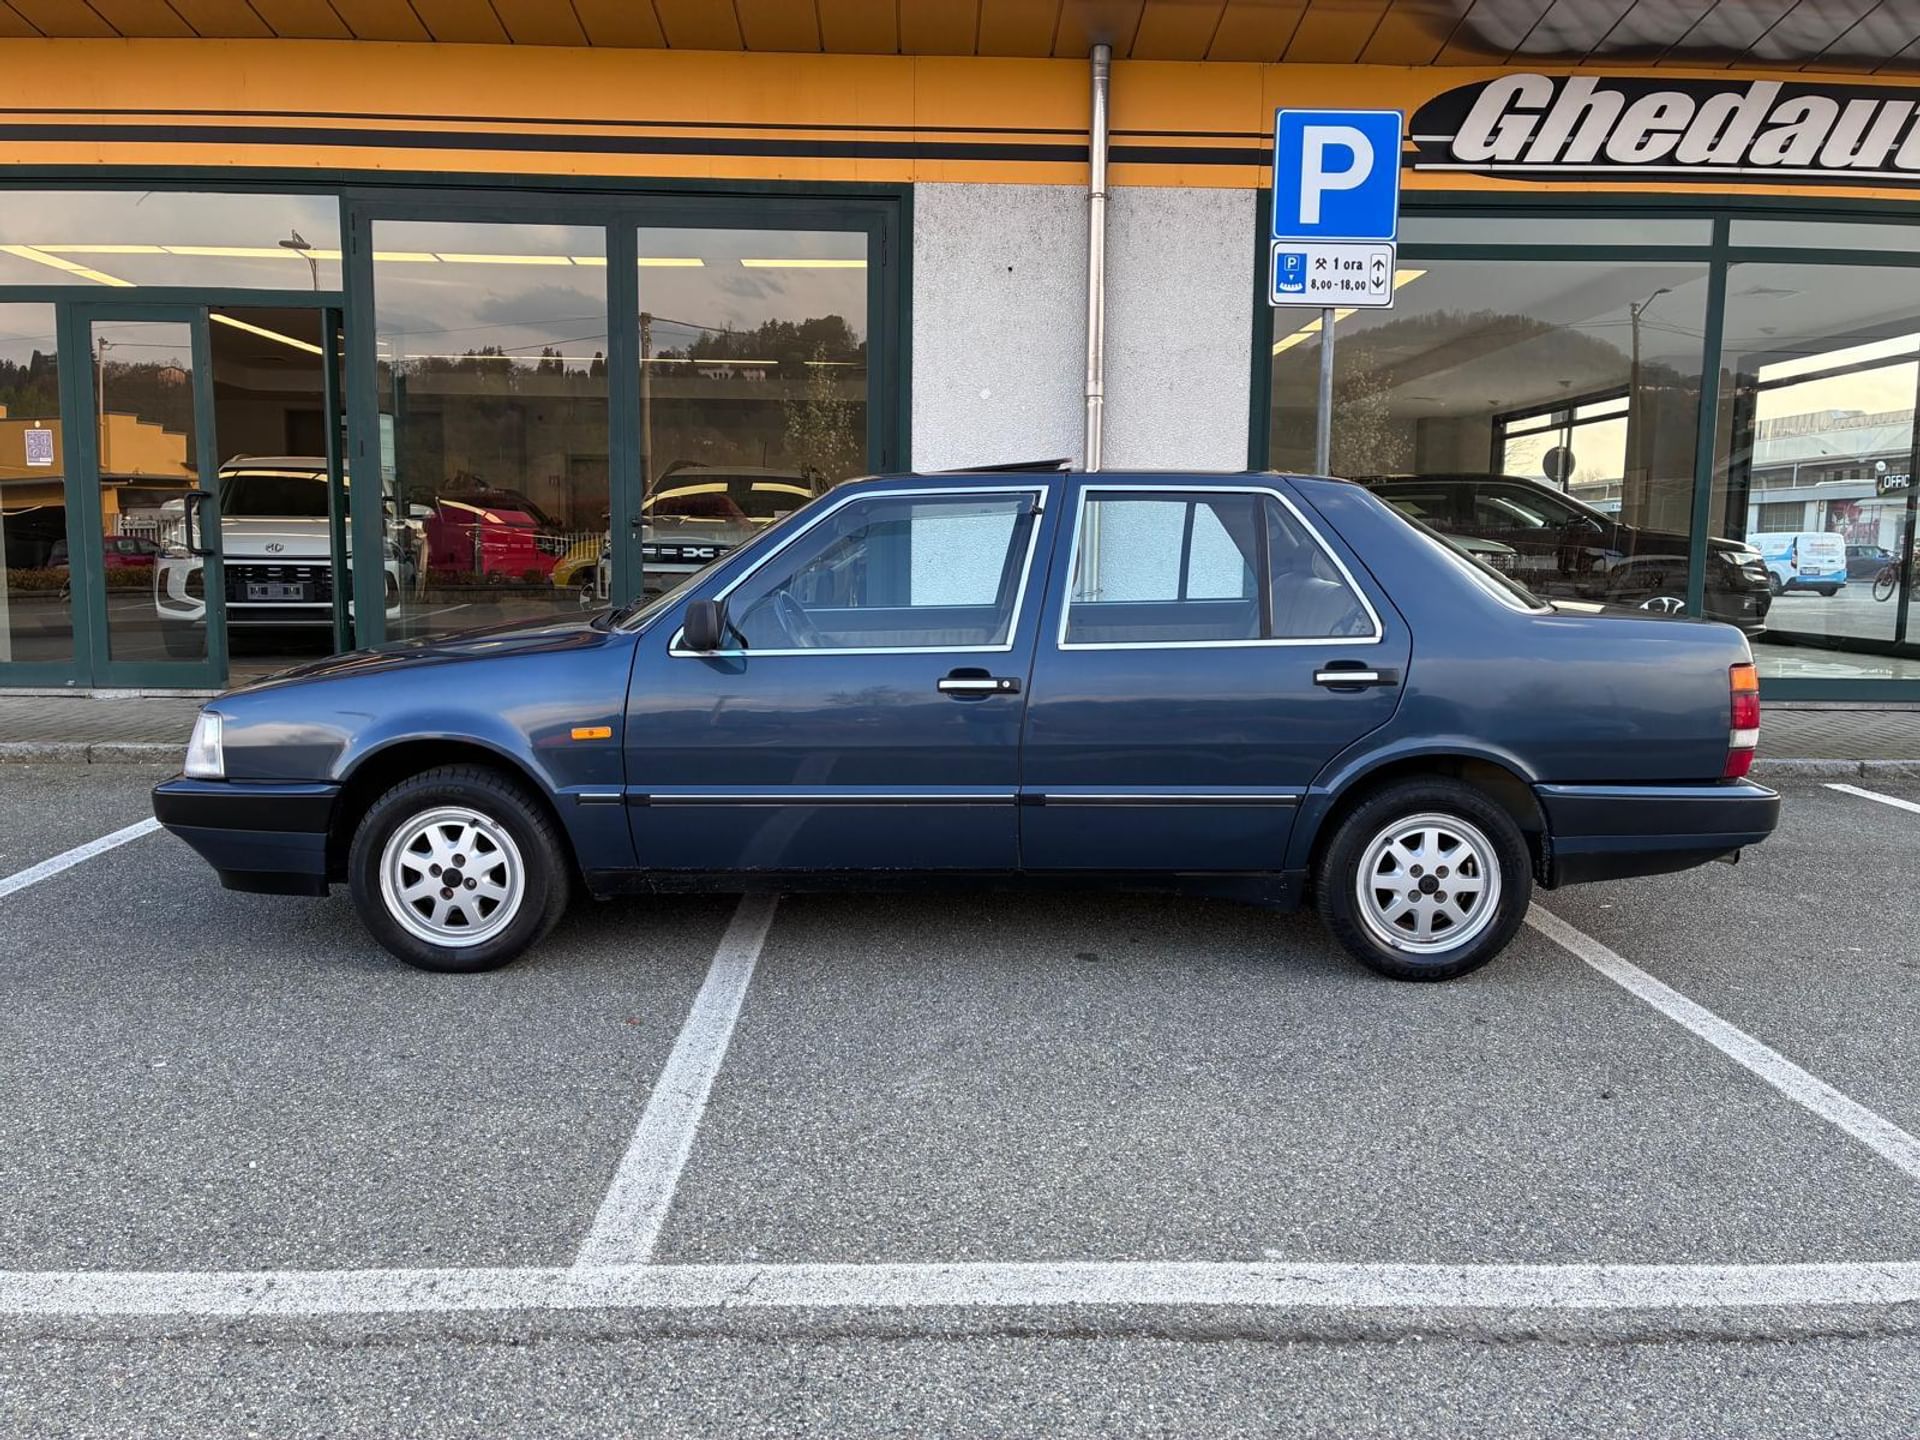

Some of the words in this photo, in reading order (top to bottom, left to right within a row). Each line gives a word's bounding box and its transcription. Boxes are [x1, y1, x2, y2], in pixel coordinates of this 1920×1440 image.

[1299, 125, 1374, 224] P
[1287, 257, 1297, 269] P
[1334, 257, 1339, 270] 1
[1343, 260, 1363, 270] ora
